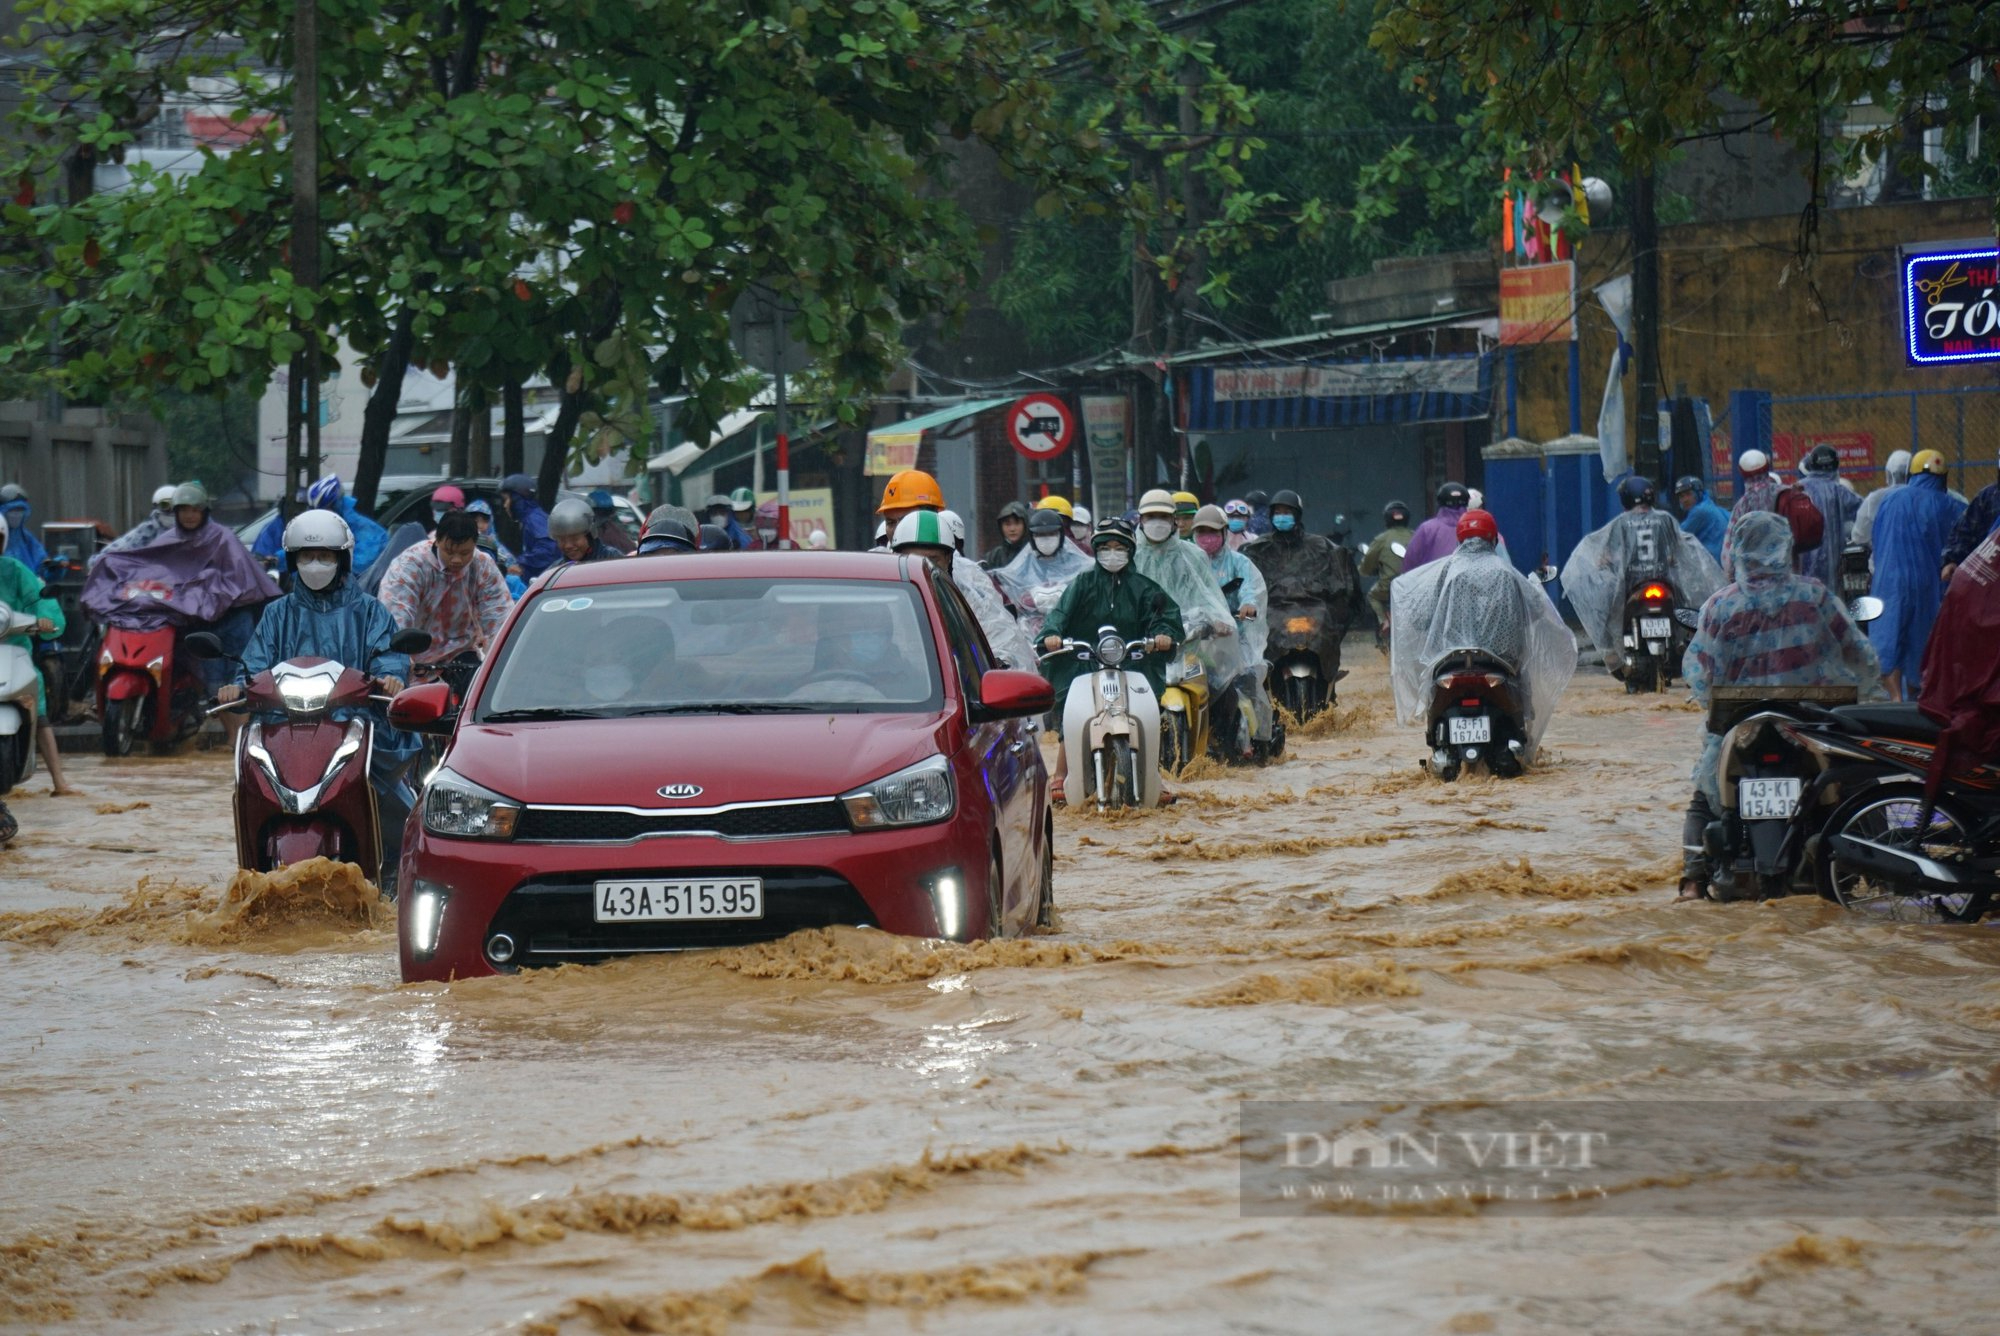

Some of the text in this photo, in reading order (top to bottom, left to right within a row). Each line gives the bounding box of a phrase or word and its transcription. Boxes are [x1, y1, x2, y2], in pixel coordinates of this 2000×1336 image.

[1924, 288, 2000, 339] TÓ
[1943, 339, 1974, 353] NAIL
[1456, 719, 1483, 730] 43-F1
[1453, 730, 1488, 742] 167.48
[665, 785, 695, 794] KIA
[1750, 781, 1790, 798] 43-K1
[602, 884, 755, 916] 43A-515.95
